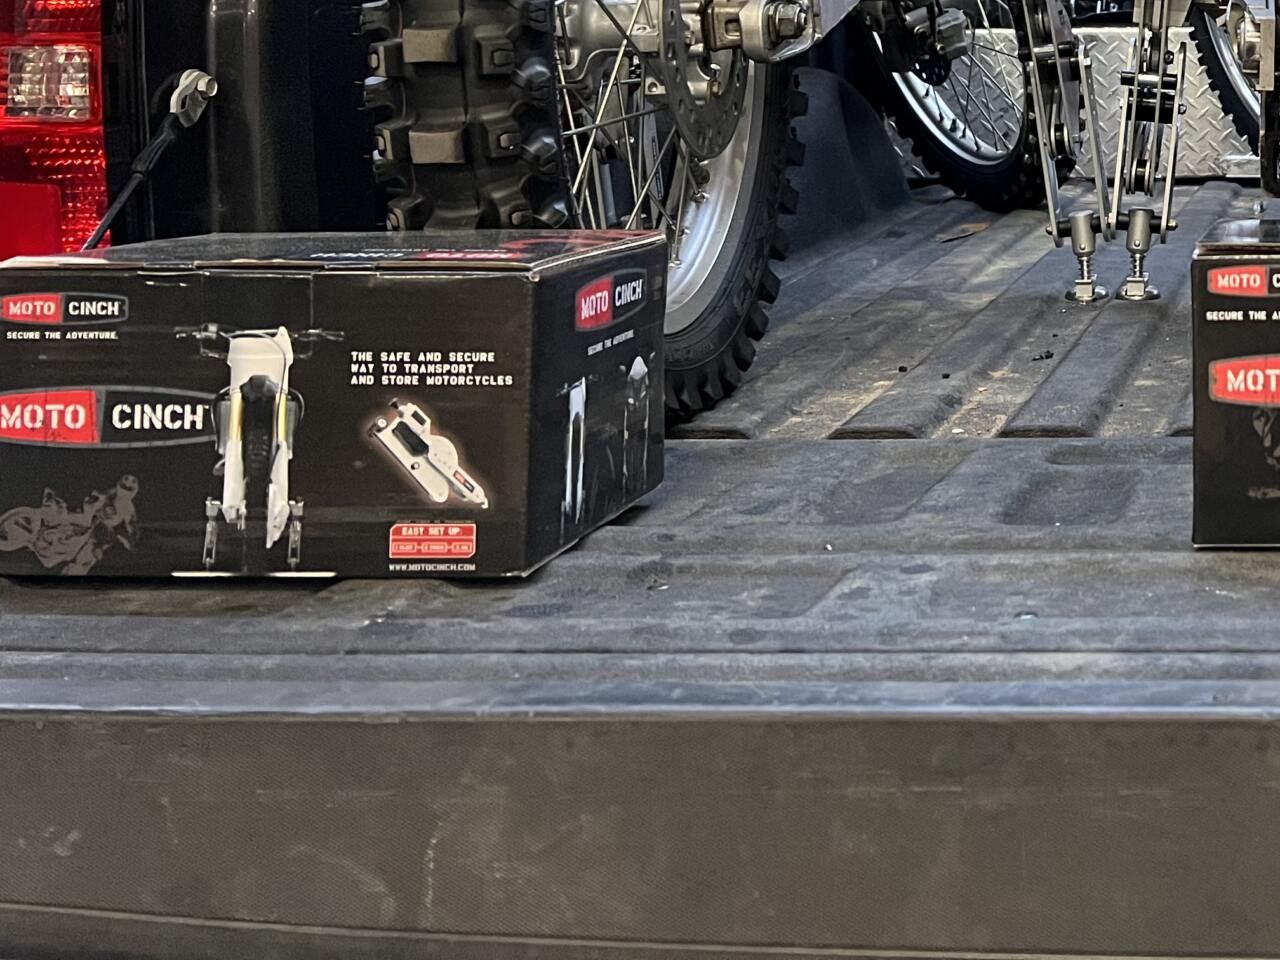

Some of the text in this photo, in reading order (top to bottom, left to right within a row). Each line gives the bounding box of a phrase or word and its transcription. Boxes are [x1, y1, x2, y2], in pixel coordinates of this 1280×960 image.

[1217, 273, 1261, 288] MOTO
[581, 278, 643, 320] MOTO CINCH
[9, 301, 119, 315] MOTO CINCH
[1206, 311, 1244, 320] SECURE
[1248, 311, 1267, 320] THE
[6, 331, 40, 339] SECURE
[45, 331, 60, 339] THE
[351, 351, 495, 362] THE SAFE AND SECURE
[351, 363, 474, 374] WAY TO TRANSPORT
[351, 375, 513, 386] AND STORE MOTORCYCLES
[0, 403, 204, 430] MOTO CINCH
[402, 526, 425, 536] EASY
[389, 563, 476, 572] WWW.MOTOCINCH.COM
